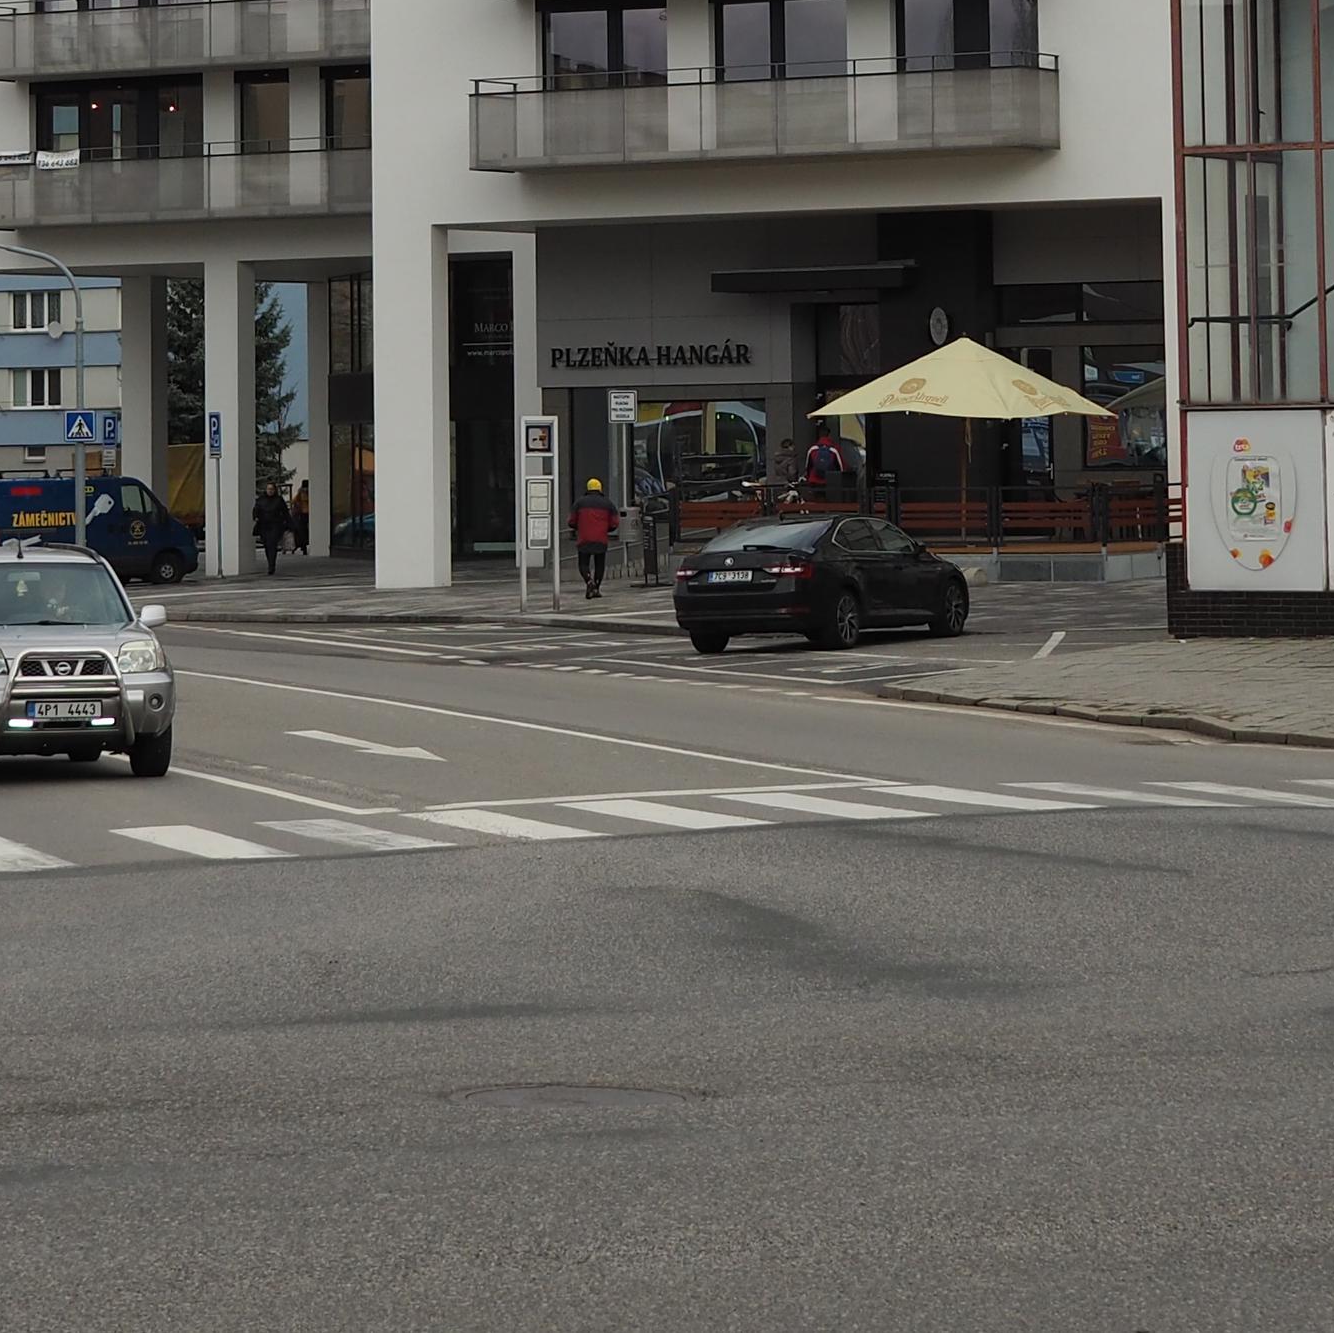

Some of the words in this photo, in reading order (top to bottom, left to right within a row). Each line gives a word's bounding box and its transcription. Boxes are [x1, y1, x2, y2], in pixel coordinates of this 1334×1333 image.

[551, 342, 650, 368] PLZEŇKA
[656, 338, 752, 365] HANGÁR
[12, 510, 76, 527] ZÁMEČNICTV
[37, 704, 59, 716] 4P1
[68, 703, 96, 715] 4443
